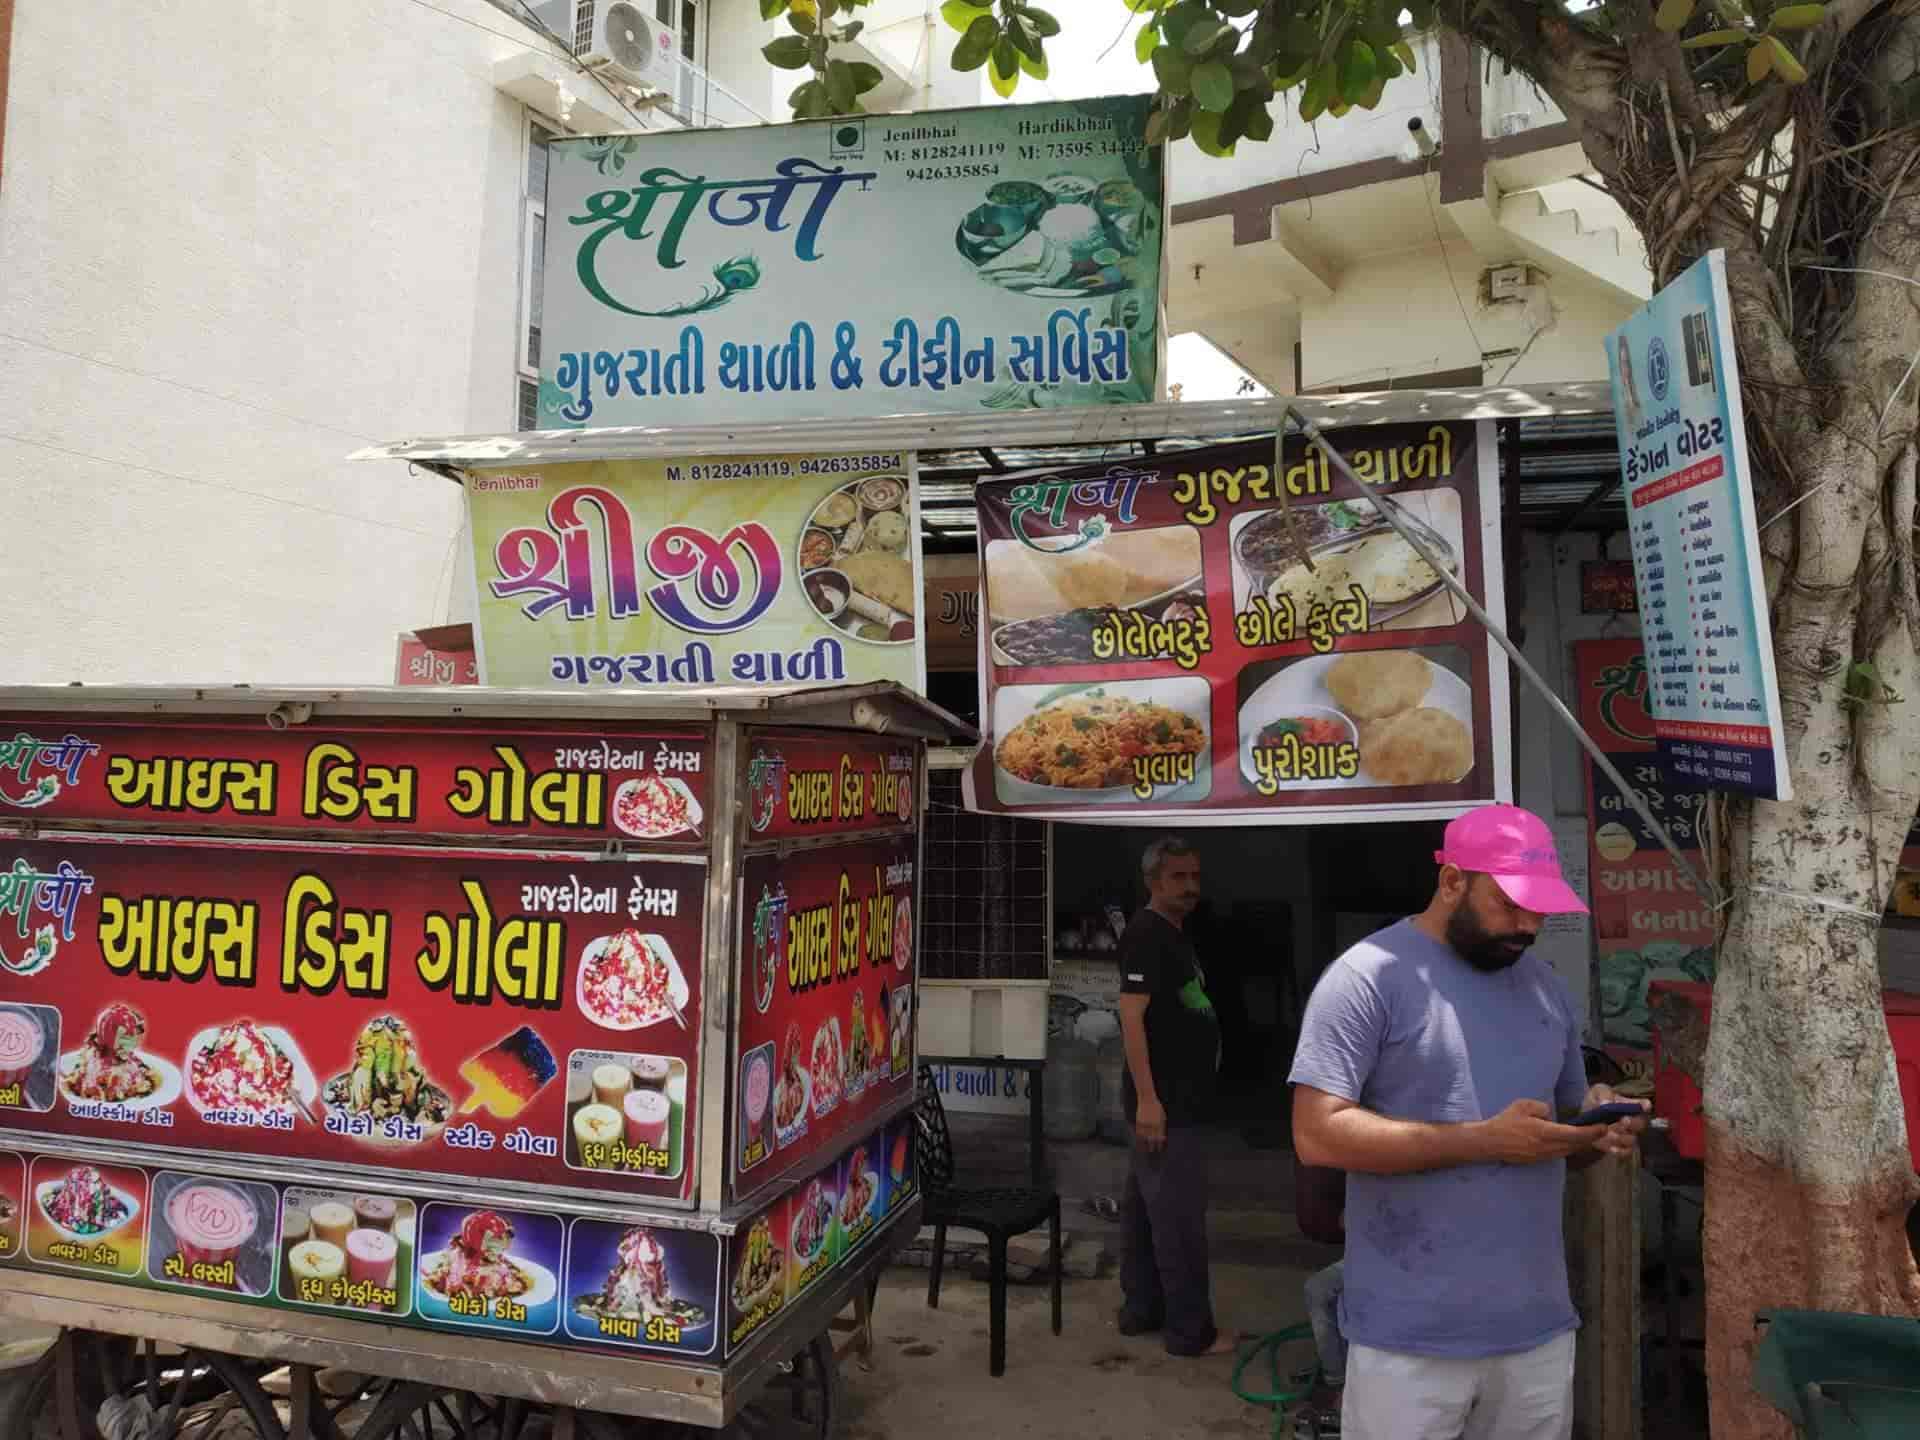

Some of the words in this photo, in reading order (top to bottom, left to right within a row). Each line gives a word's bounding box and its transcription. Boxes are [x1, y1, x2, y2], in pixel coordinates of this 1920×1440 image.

[883, 125, 957, 142] Jenilbhai
[1018, 117, 1112, 136] Hardikbhai
[884, 149, 905, 162] M:
[911, 142, 1005, 161] 8128241119
[906, 164, 999, 181] 9426335854
[556, 325, 705, 421] ગુજરાતી
[718, 320, 816, 393] થાળી
[830, 320, 863, 390] &
[878, 316, 996, 390] ટીફીન
[1008, 307, 1128, 384] સર્વિસ
[1677, 416, 1725, 457] વોટર
[667, 466, 685, 481] M.
[691, 461, 794, 480] 8128241119,
[800, 455, 900, 474] 9426335854
[1352, 425, 1452, 485] થાળી
[1236, 594, 1295, 646] છોલે
[731, 637, 846, 682] થાળી
[554, 741, 645, 771] રાજકોટના
[653, 742, 701, 776] ફેમસ
[1133, 753, 1195, 798] પુલાવ
[1254, 733, 1359, 796] પુરીશાક
[302, 743, 416, 820] ડિસ
[446, 746, 603, 826] ગોલા
[521, 875, 617, 914] રાજકોટના
[627, 875, 679, 920] ફેમસ
[280, 875, 389, 992] ડિસ
[416, 880, 565, 1003] ગોલા
[143, 1107, 174, 1126] ડીસ
[203, 1110, 255, 1125] નવરંગ
[262, 1109, 294, 1129] ડીસ
[325, 1106, 373, 1136] ચોકો
[383, 1115, 422, 1141] ડીસ
[445, 1123, 495, 1149] સ્ટીક
[502, 1126, 557, 1157] ગોલા
[48, 1240, 88, 1261] નવરંગ
[93, 1244, 119, 1265] ડીસ
[449, 1292, 488, 1316] ચોકો
[495, 1297, 527, 1322] ડીસ
[599, 1315, 637, 1338] માવા
[646, 1315, 681, 1343] ડીસ
